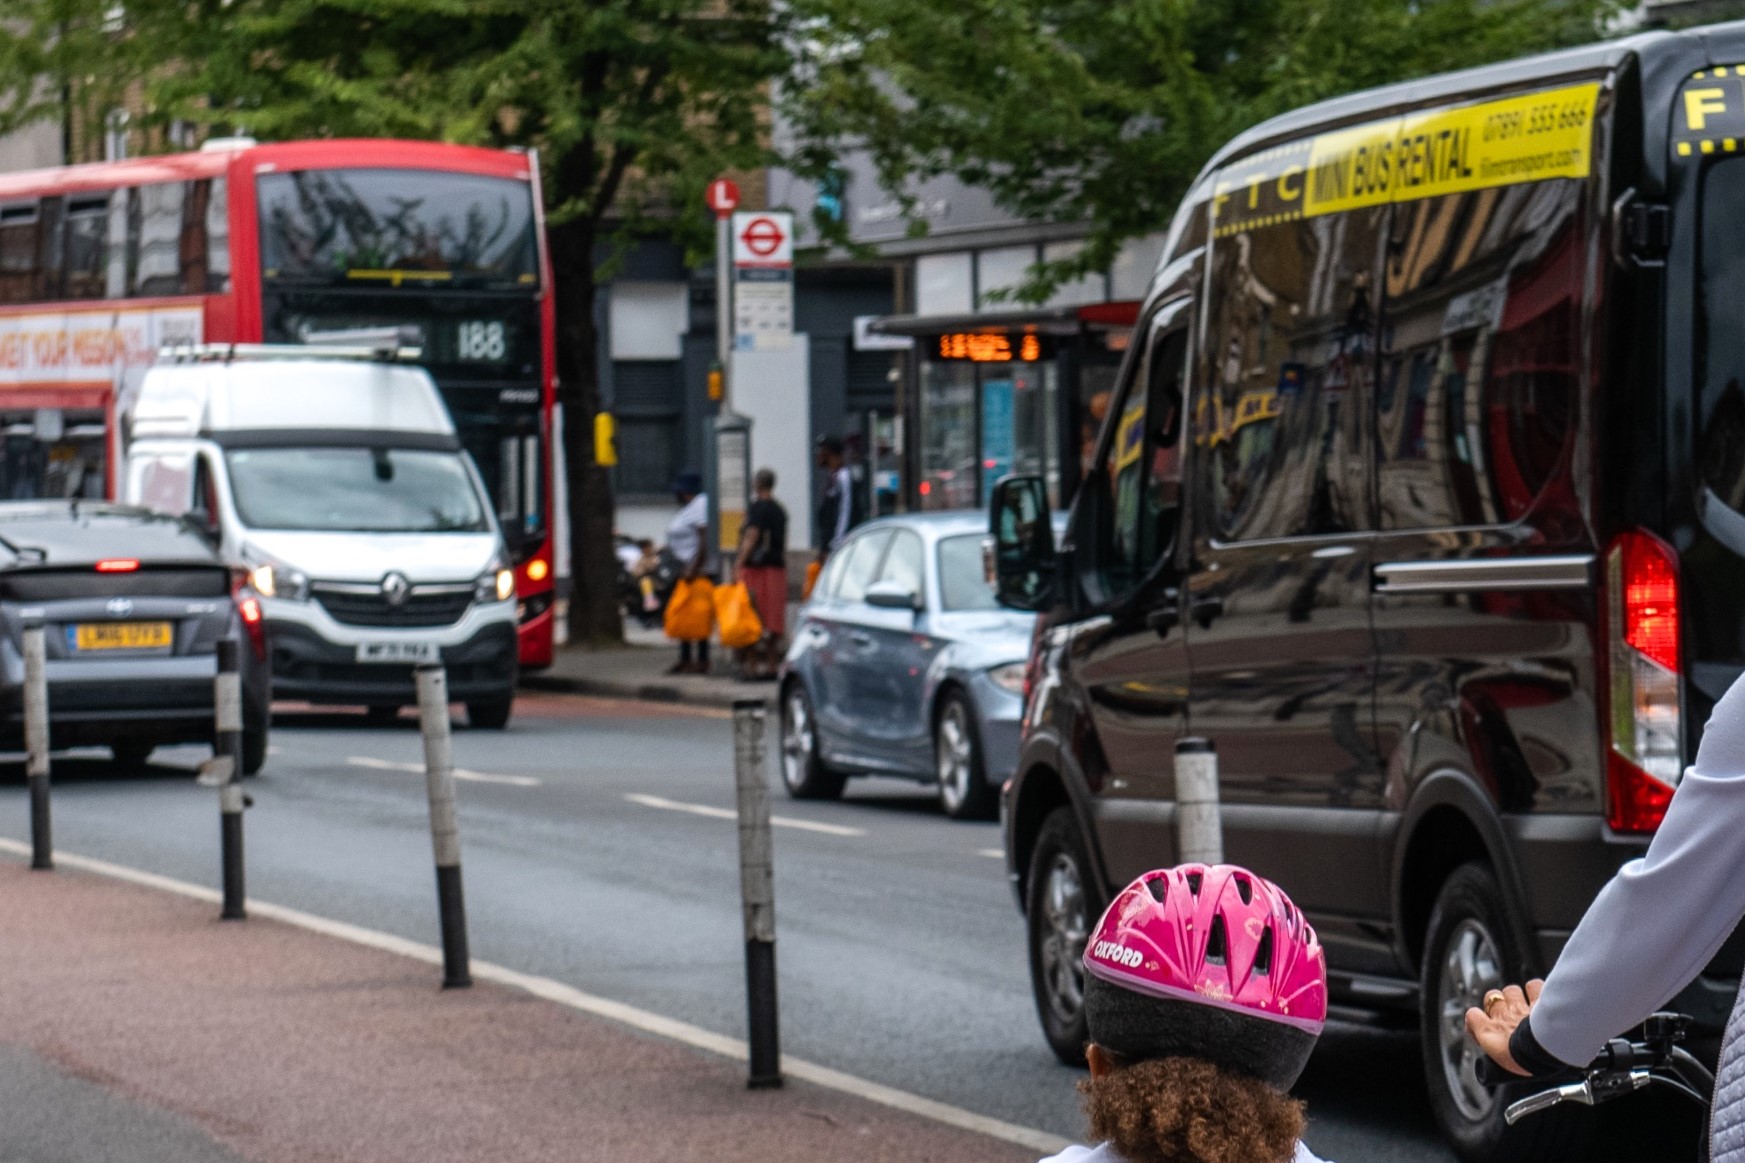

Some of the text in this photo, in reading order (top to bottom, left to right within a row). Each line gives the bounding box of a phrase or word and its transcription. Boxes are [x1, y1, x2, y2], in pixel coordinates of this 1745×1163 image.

[1527, 103, 1558, 135] 555
[1559, 97, 1587, 129] 666
[1353, 139, 1392, 196] BUS
[1395, 126, 1472, 188] RENTAL
[714, 179, 736, 210] L
[459, 320, 505, 359] 188
[1094, 940, 1144, 968] OXFORD
